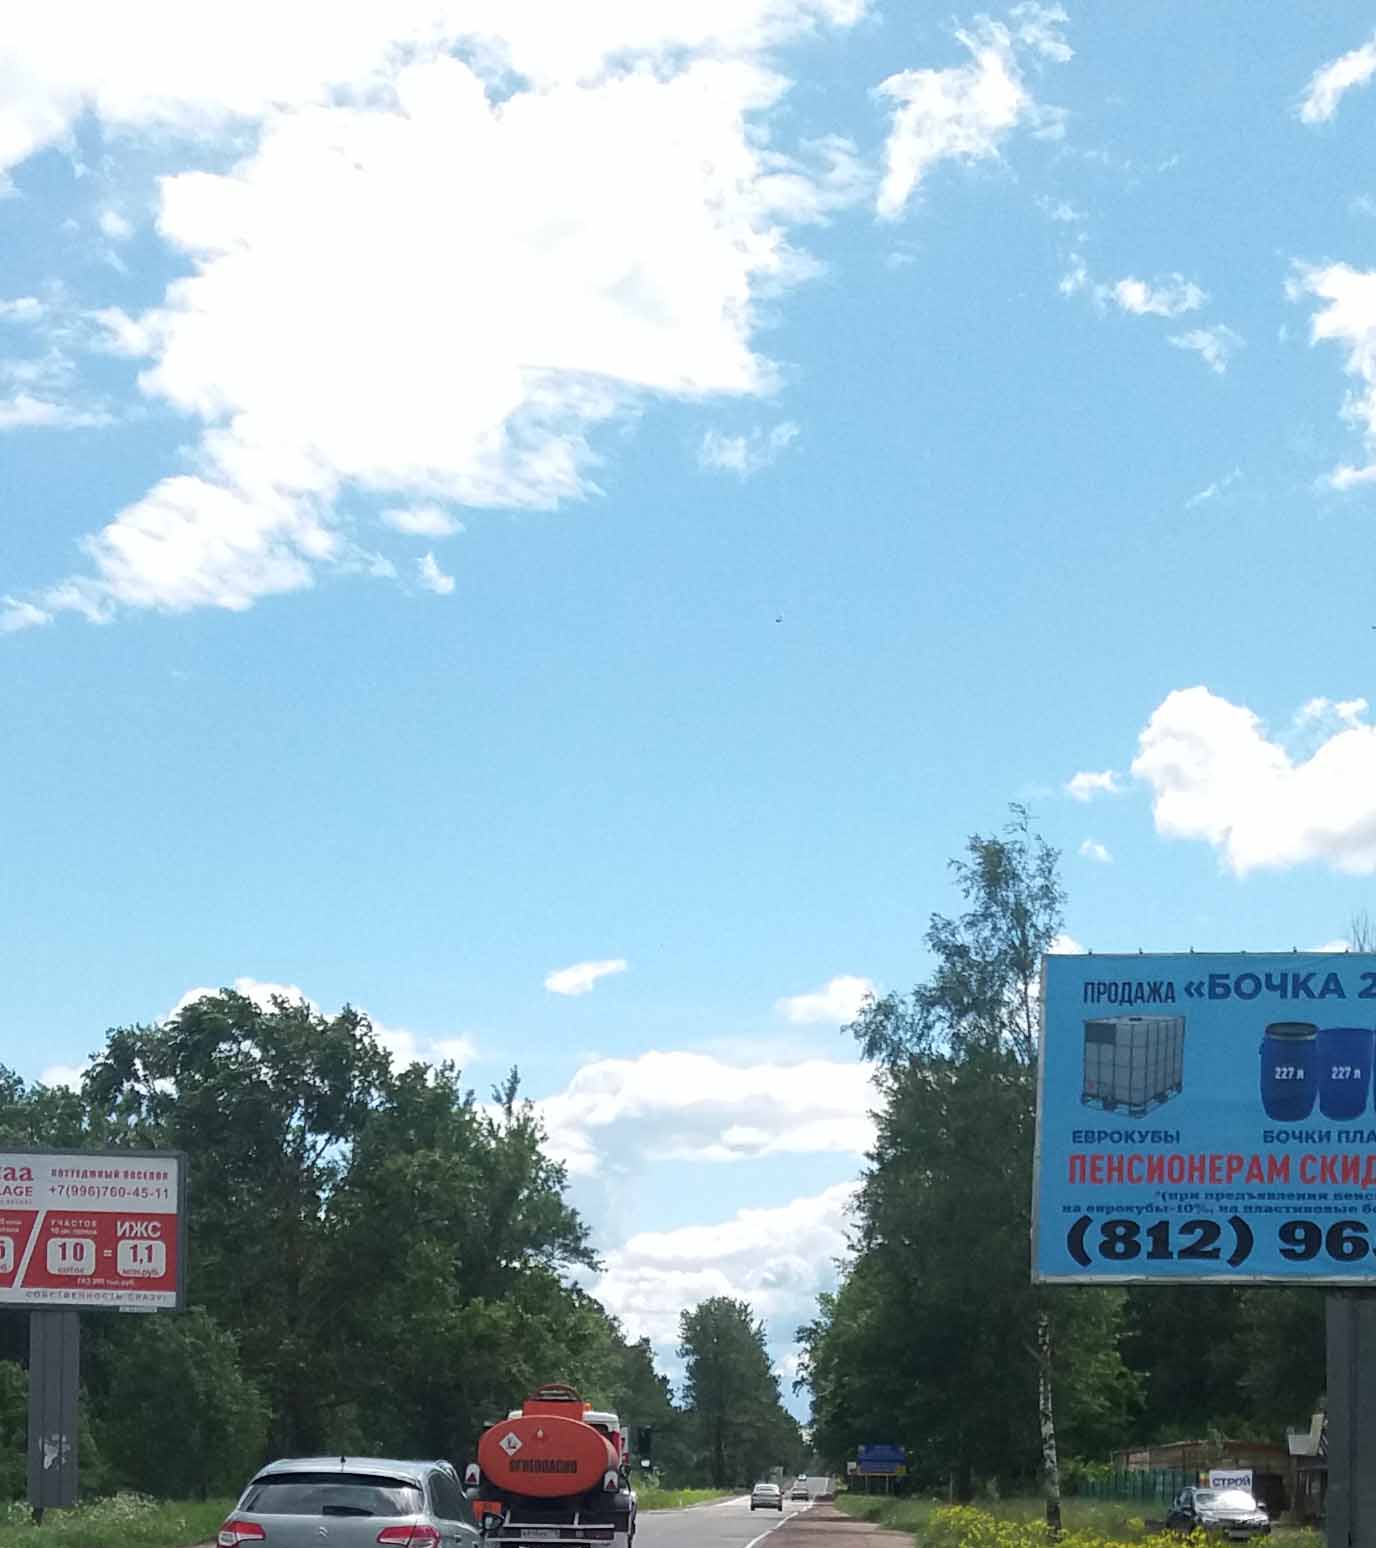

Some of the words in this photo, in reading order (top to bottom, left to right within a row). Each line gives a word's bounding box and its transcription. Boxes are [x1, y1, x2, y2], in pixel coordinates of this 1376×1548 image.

[1082, 981, 1176, 1006] ПРОДАЖА
[1183, 972, 1346, 1000] «БОЧКА
[1274, 1066, 1295, 1080] 227
[1331, 1066, 1351, 1080] 227
[1071, 1130, 1180, 1144] ЕВРОКУБЫ
[1263, 1129, 1331, 1144] БОЧКИ
[1068, 1154, 1290, 1185] ПЕНСИОНЕРАМ
[116, 1220, 161, 1238] ИЖС
[1067, 1215, 1254, 1268] (812)
[58, 1242, 85, 1262] 10
[129, 1244, 154, 1264] 1,1
[1212, 1475, 1251, 1488] СТРОЙ
